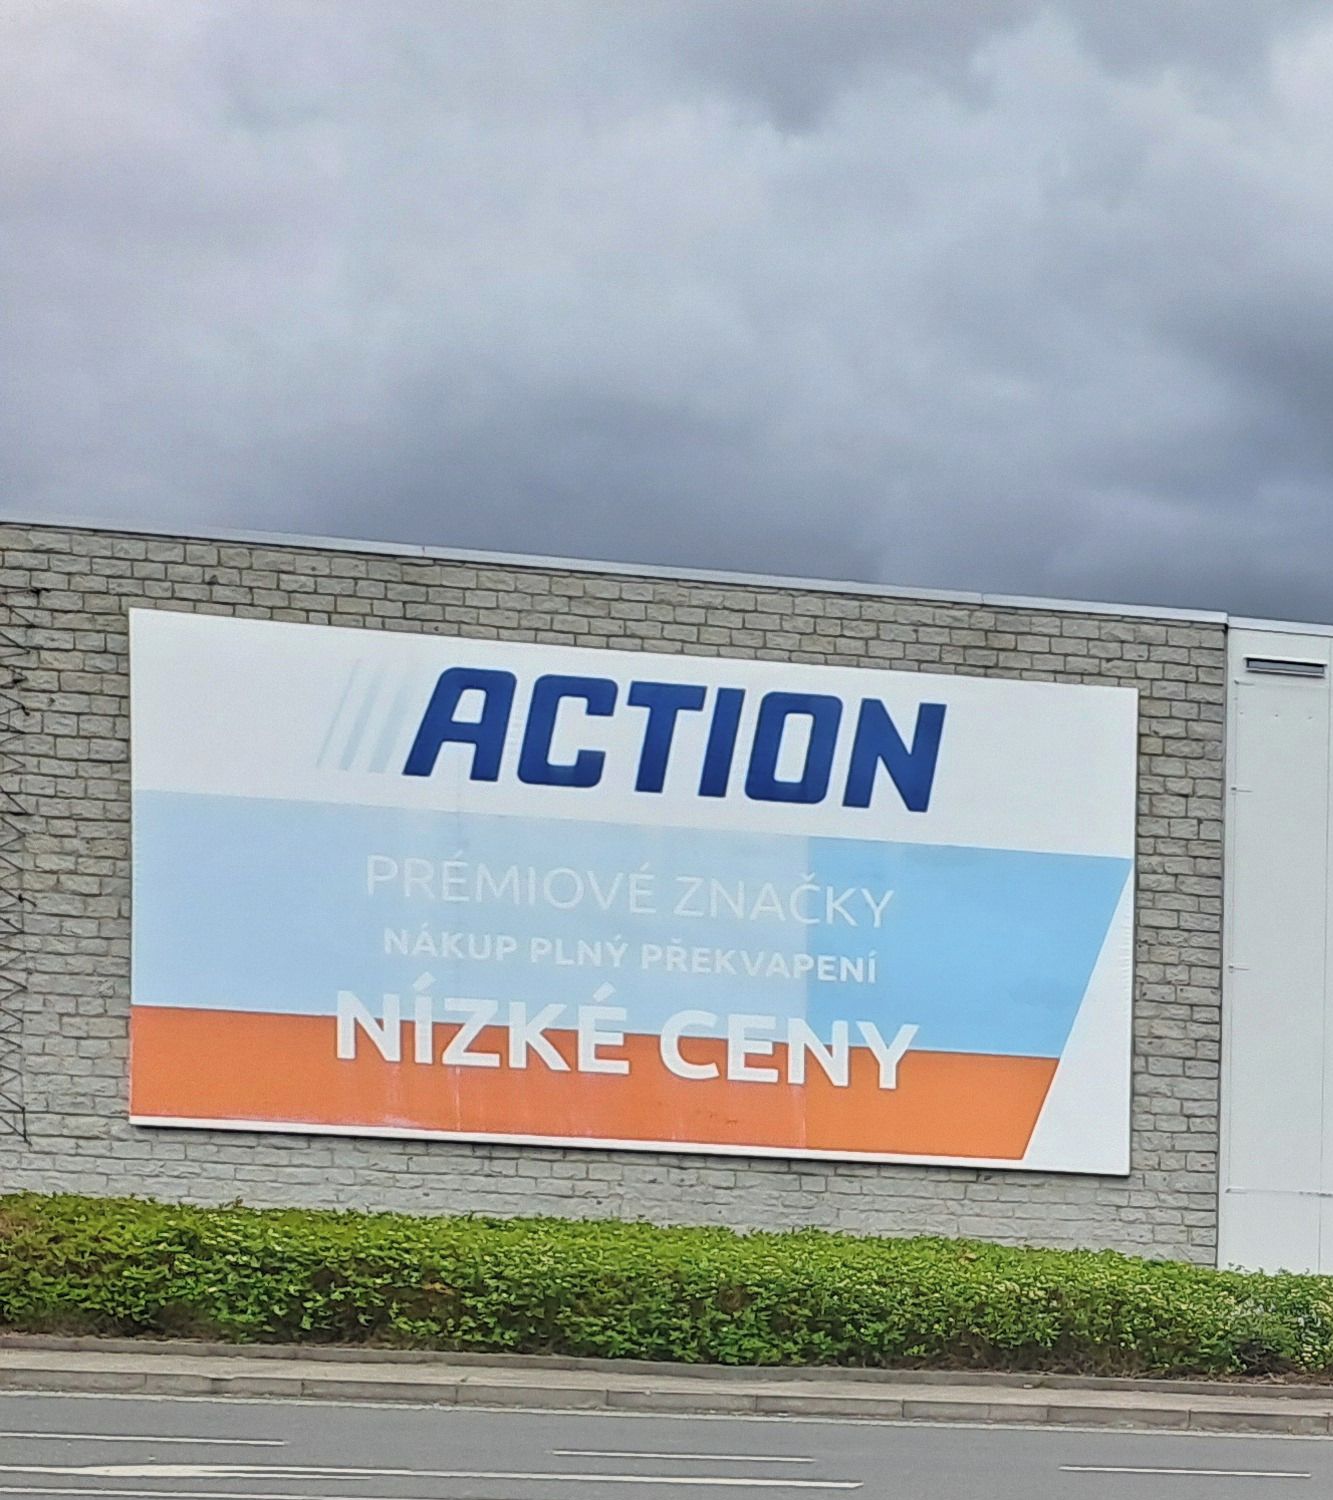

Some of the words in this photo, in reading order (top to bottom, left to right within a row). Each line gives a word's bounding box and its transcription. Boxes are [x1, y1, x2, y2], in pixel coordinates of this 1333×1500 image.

[402, 667, 947, 813] ACTION
[366, 850, 657, 914] PRÉMIOVÉ
[673, 872, 895, 928] ZNAČKY
[383, 922, 517, 961] NÁKUP
[530, 934, 628, 968] PLNÝ
[641, 937, 878, 983] PŘEKVAPENÍ
[336, 971, 631, 1076] NÍZKÉ
[659, 1010, 920, 1090] CENY
